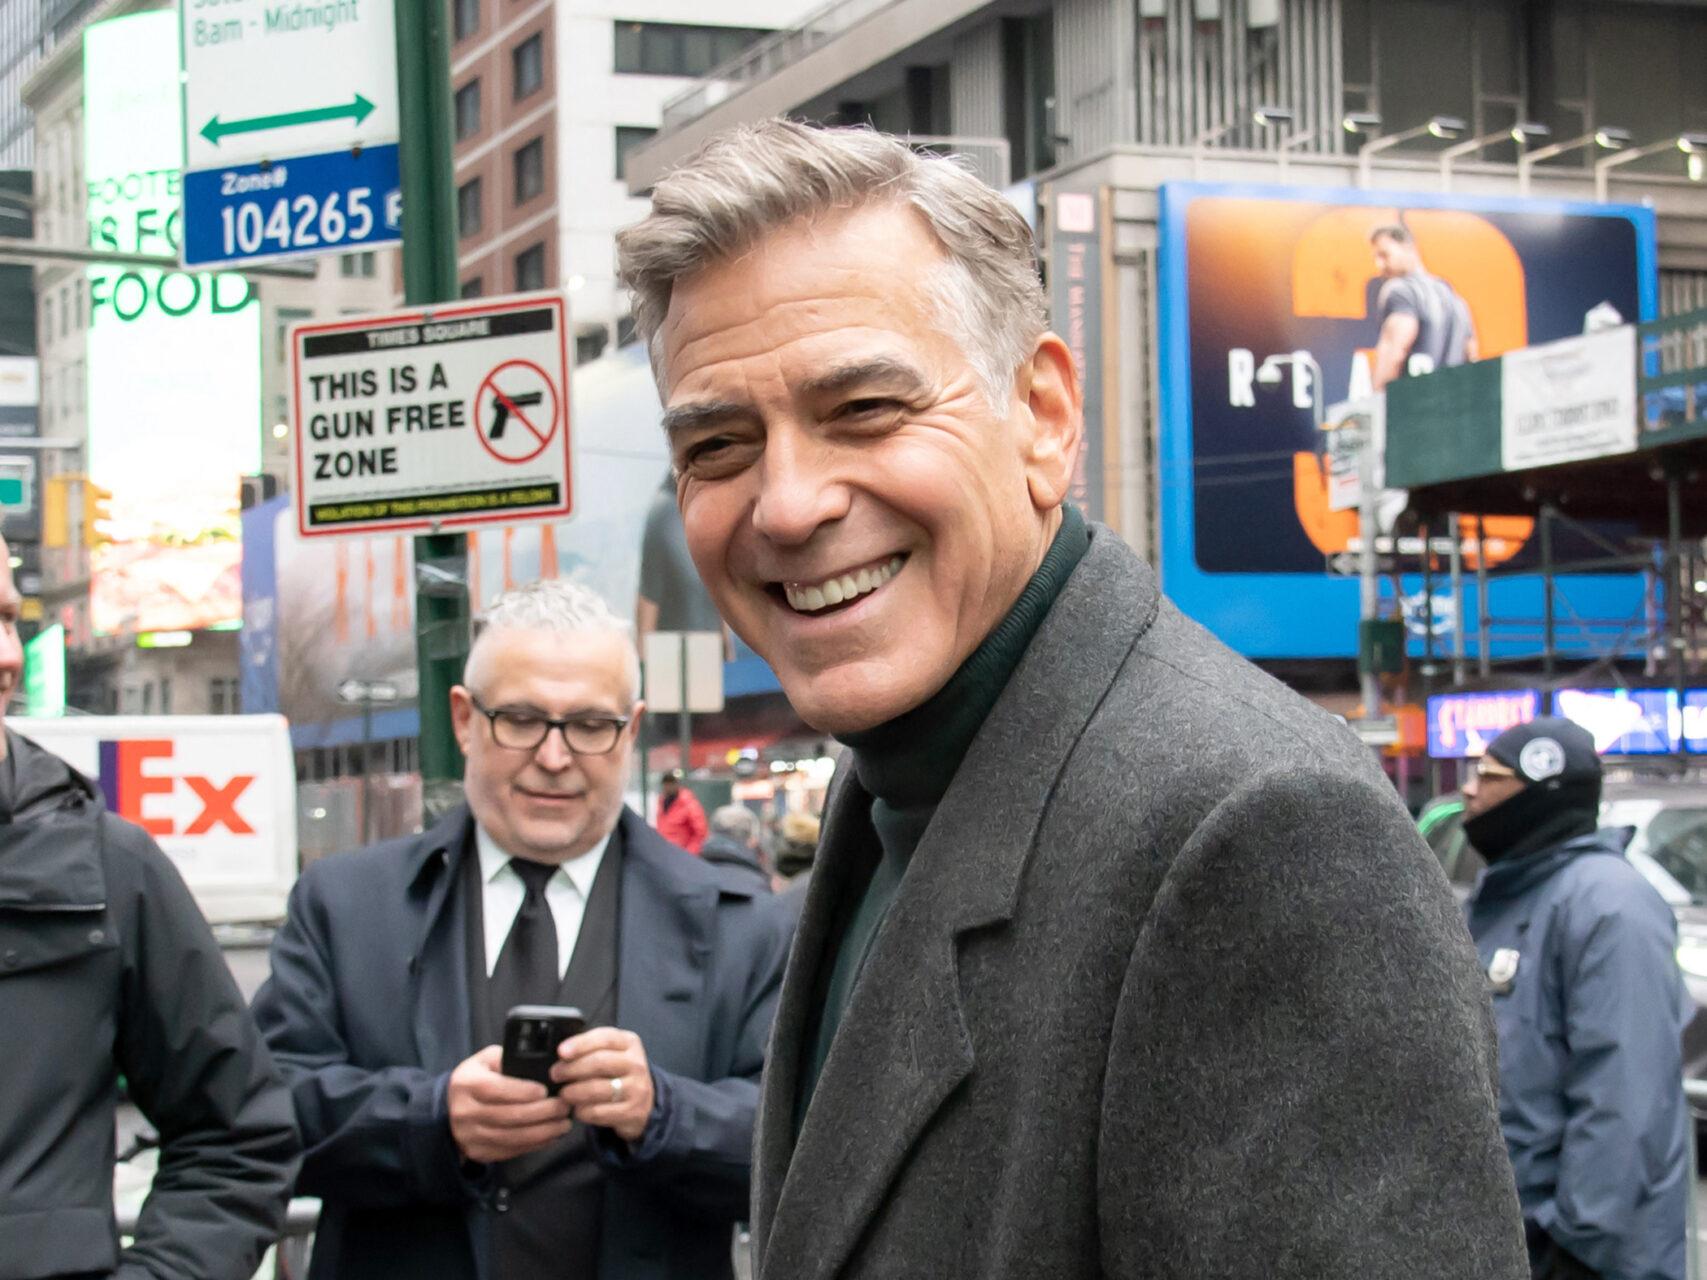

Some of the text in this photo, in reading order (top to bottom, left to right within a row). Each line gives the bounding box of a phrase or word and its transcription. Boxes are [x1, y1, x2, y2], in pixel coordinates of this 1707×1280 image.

[194, 18, 243, 47] 8am
[264, 0, 359, 34] Midnight
[221, 166, 288, 196] Zone#
[221, 187, 373, 255] 104265
[90, 272, 251, 321] FOOD
[367, 317, 491, 349] TIMES SQUARE
[309, 362, 448, 402] THIS IS A
[310, 400, 466, 441] GUN FREE
[314, 447, 398, 480] ZONE
[97, 739, 257, 835] Ex
